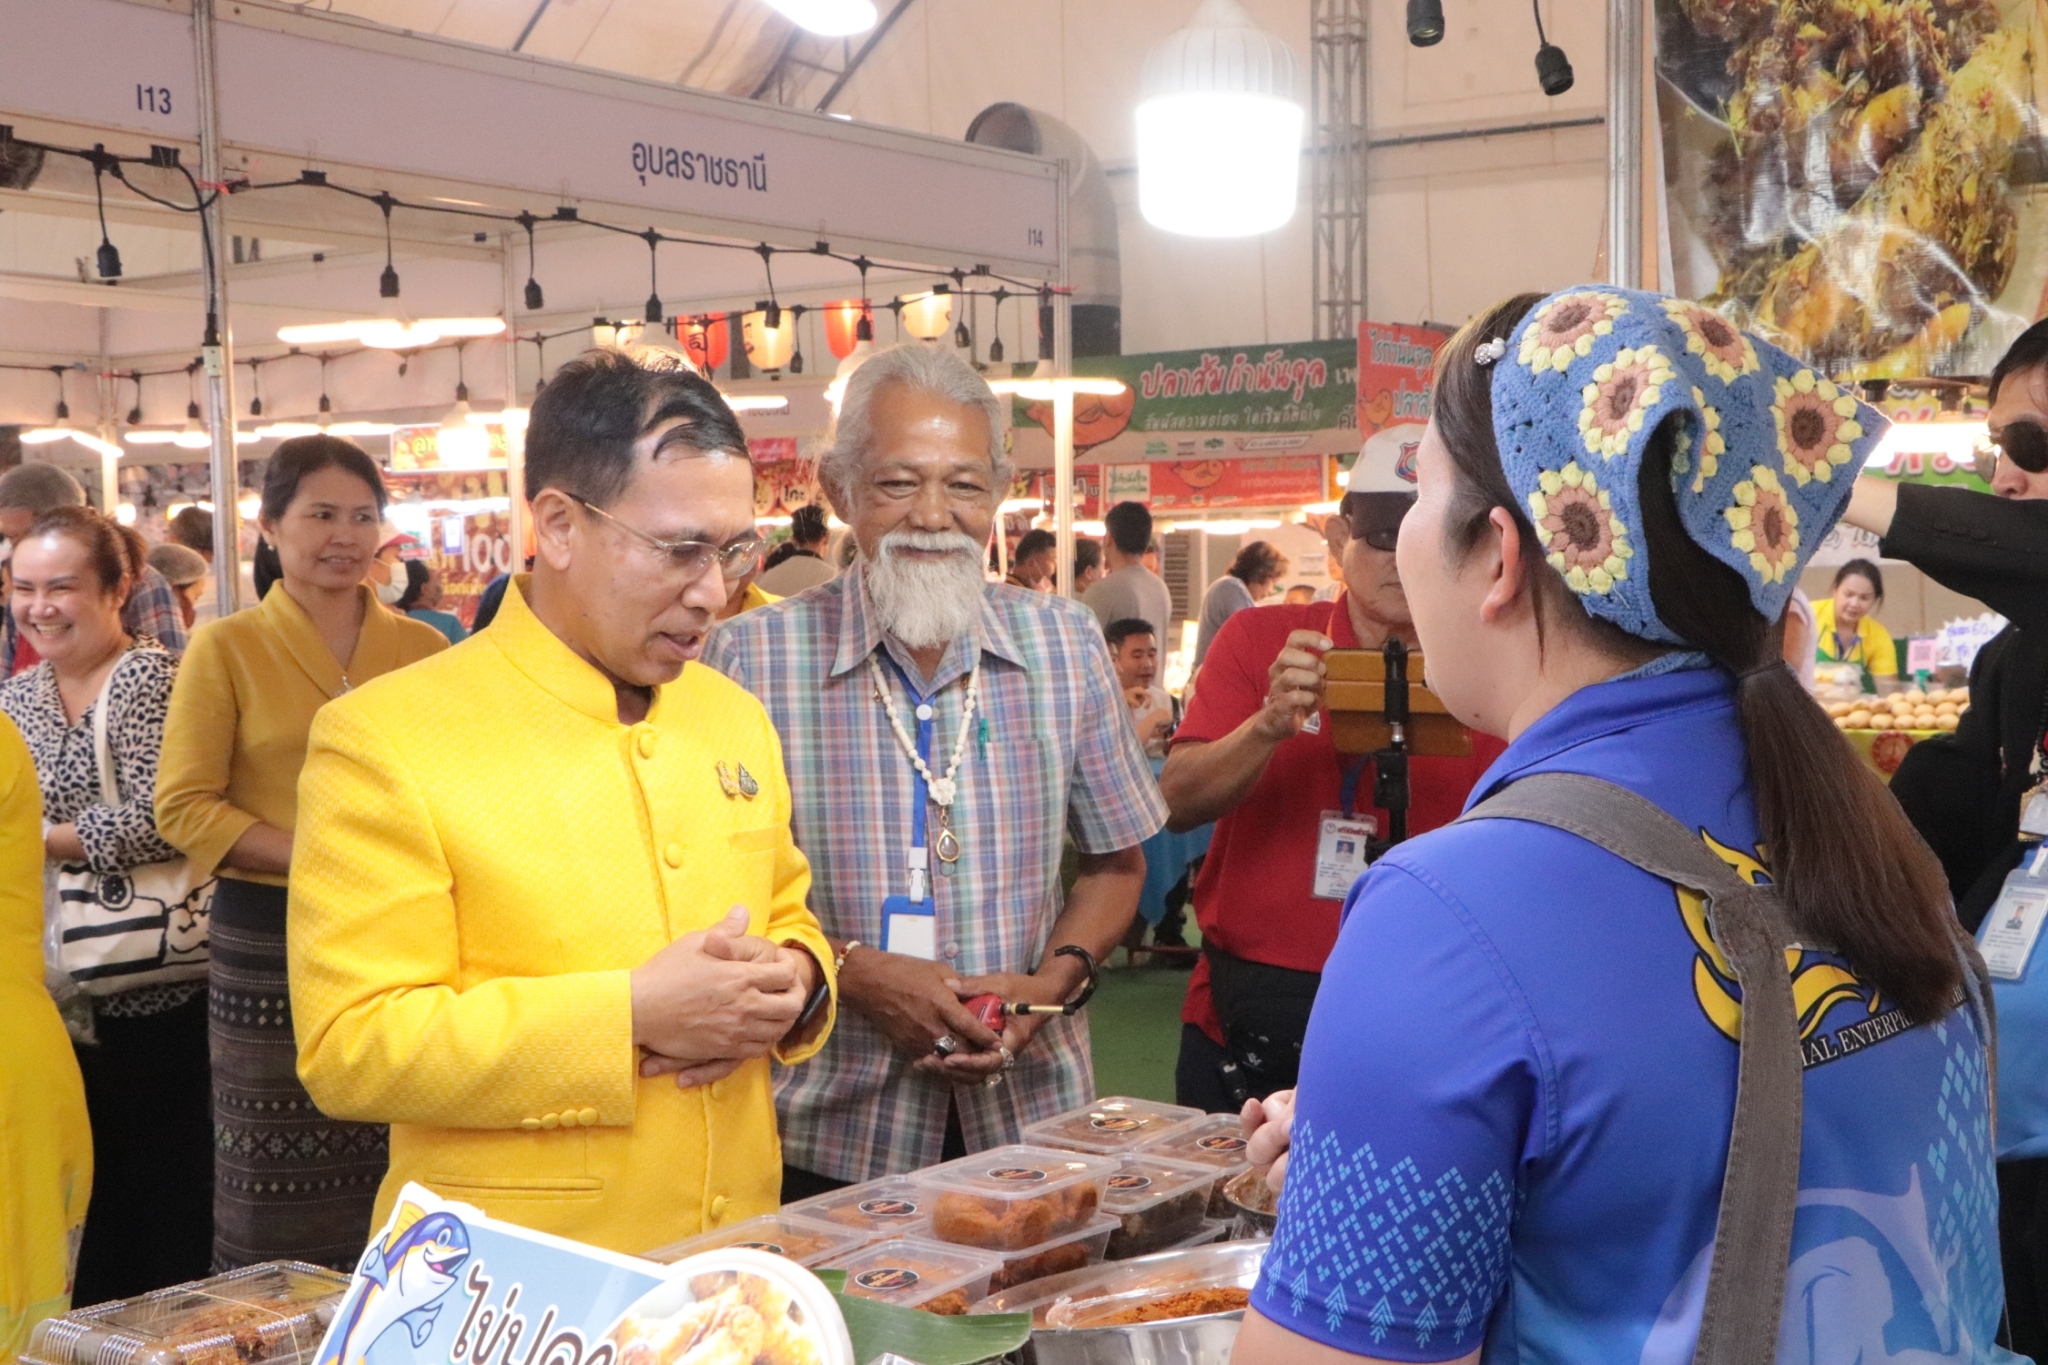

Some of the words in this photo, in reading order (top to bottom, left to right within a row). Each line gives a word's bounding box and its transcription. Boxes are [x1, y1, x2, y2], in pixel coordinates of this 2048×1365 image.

[632, 142, 767, 192] อุบลราชธานี
[1393, 378, 1433, 420] ปลาส้
[1800, 1037, 1838, 1067] IAL
